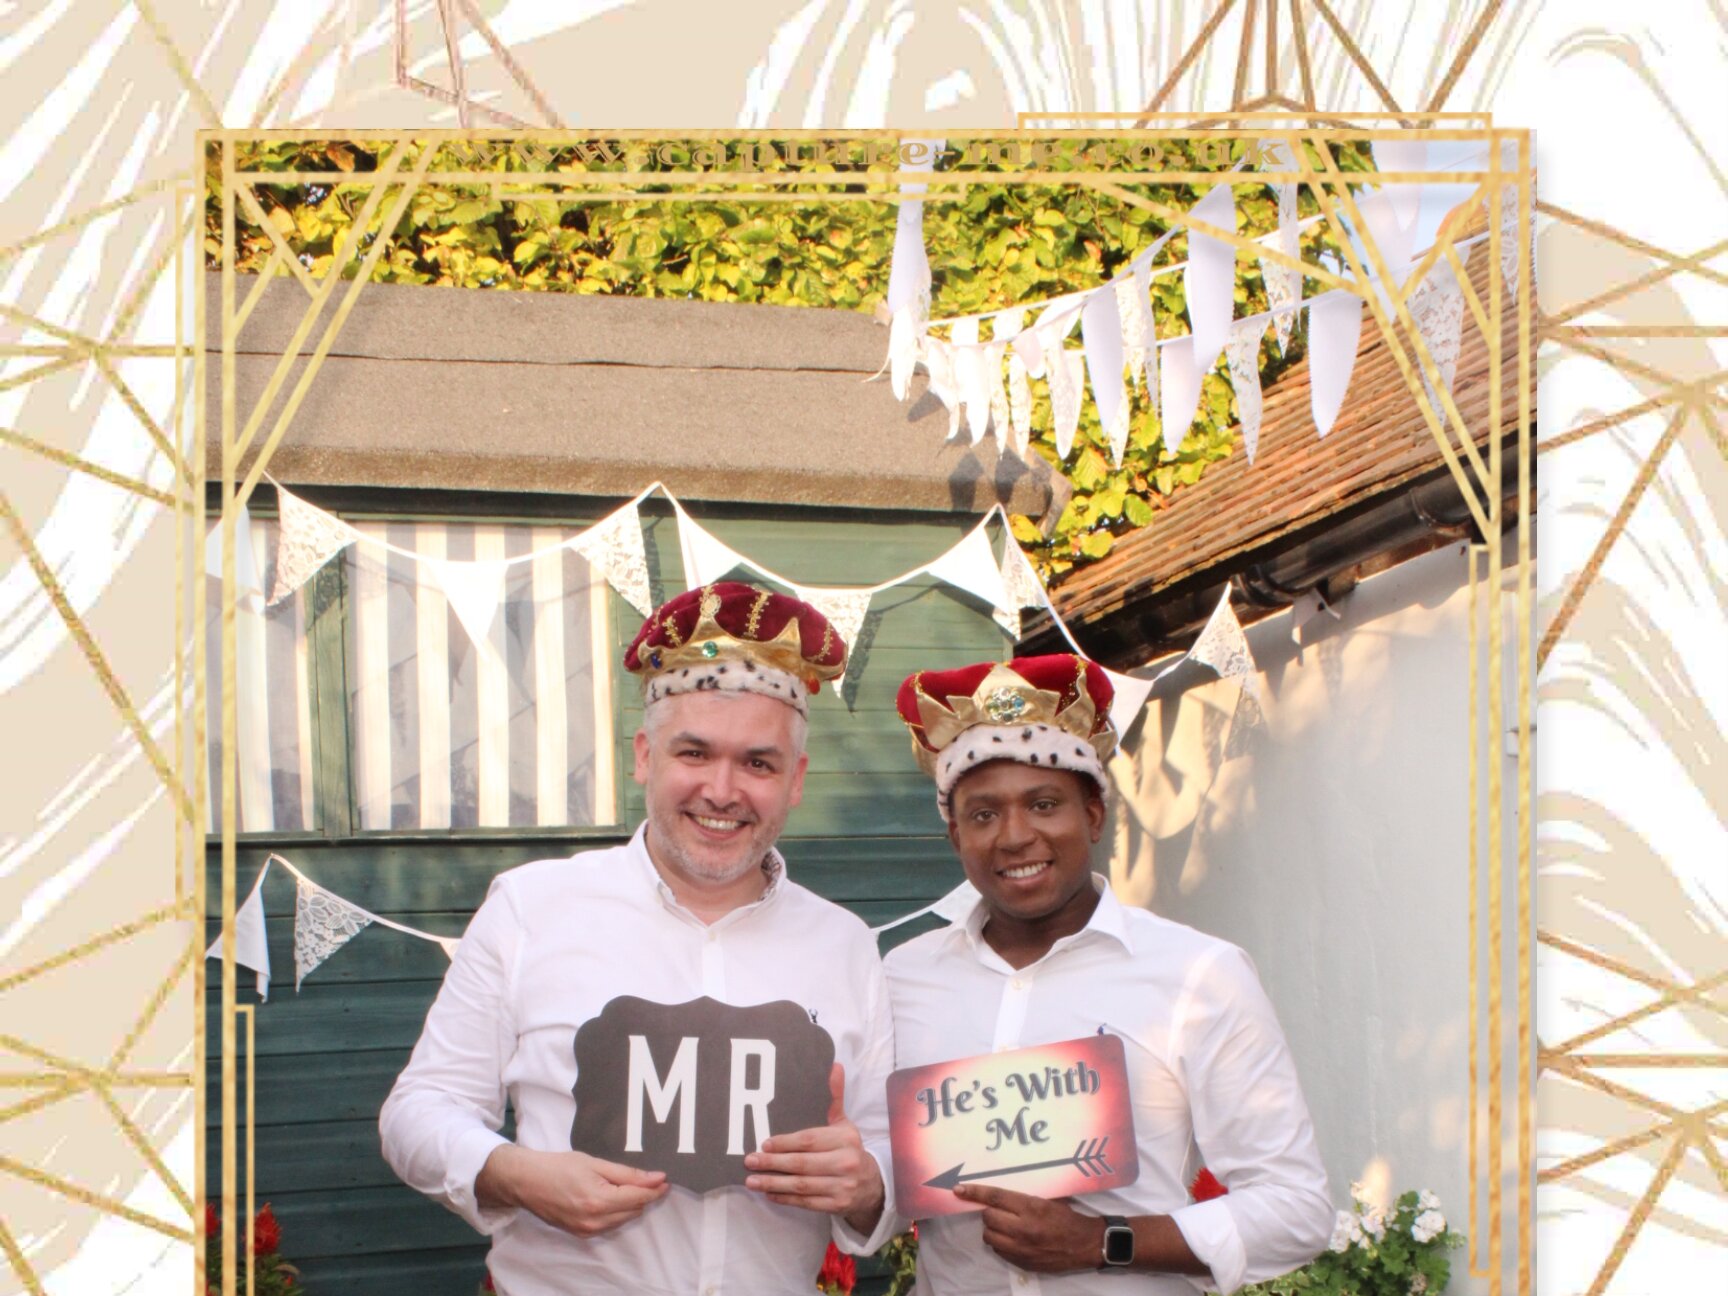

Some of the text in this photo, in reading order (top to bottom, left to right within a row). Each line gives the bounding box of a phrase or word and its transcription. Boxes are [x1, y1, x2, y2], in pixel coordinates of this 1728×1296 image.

[624, 1035, 776, 1155] MR
[915, 1060, 1100, 1128] He's With
[985, 1110, 1052, 1152] Me
